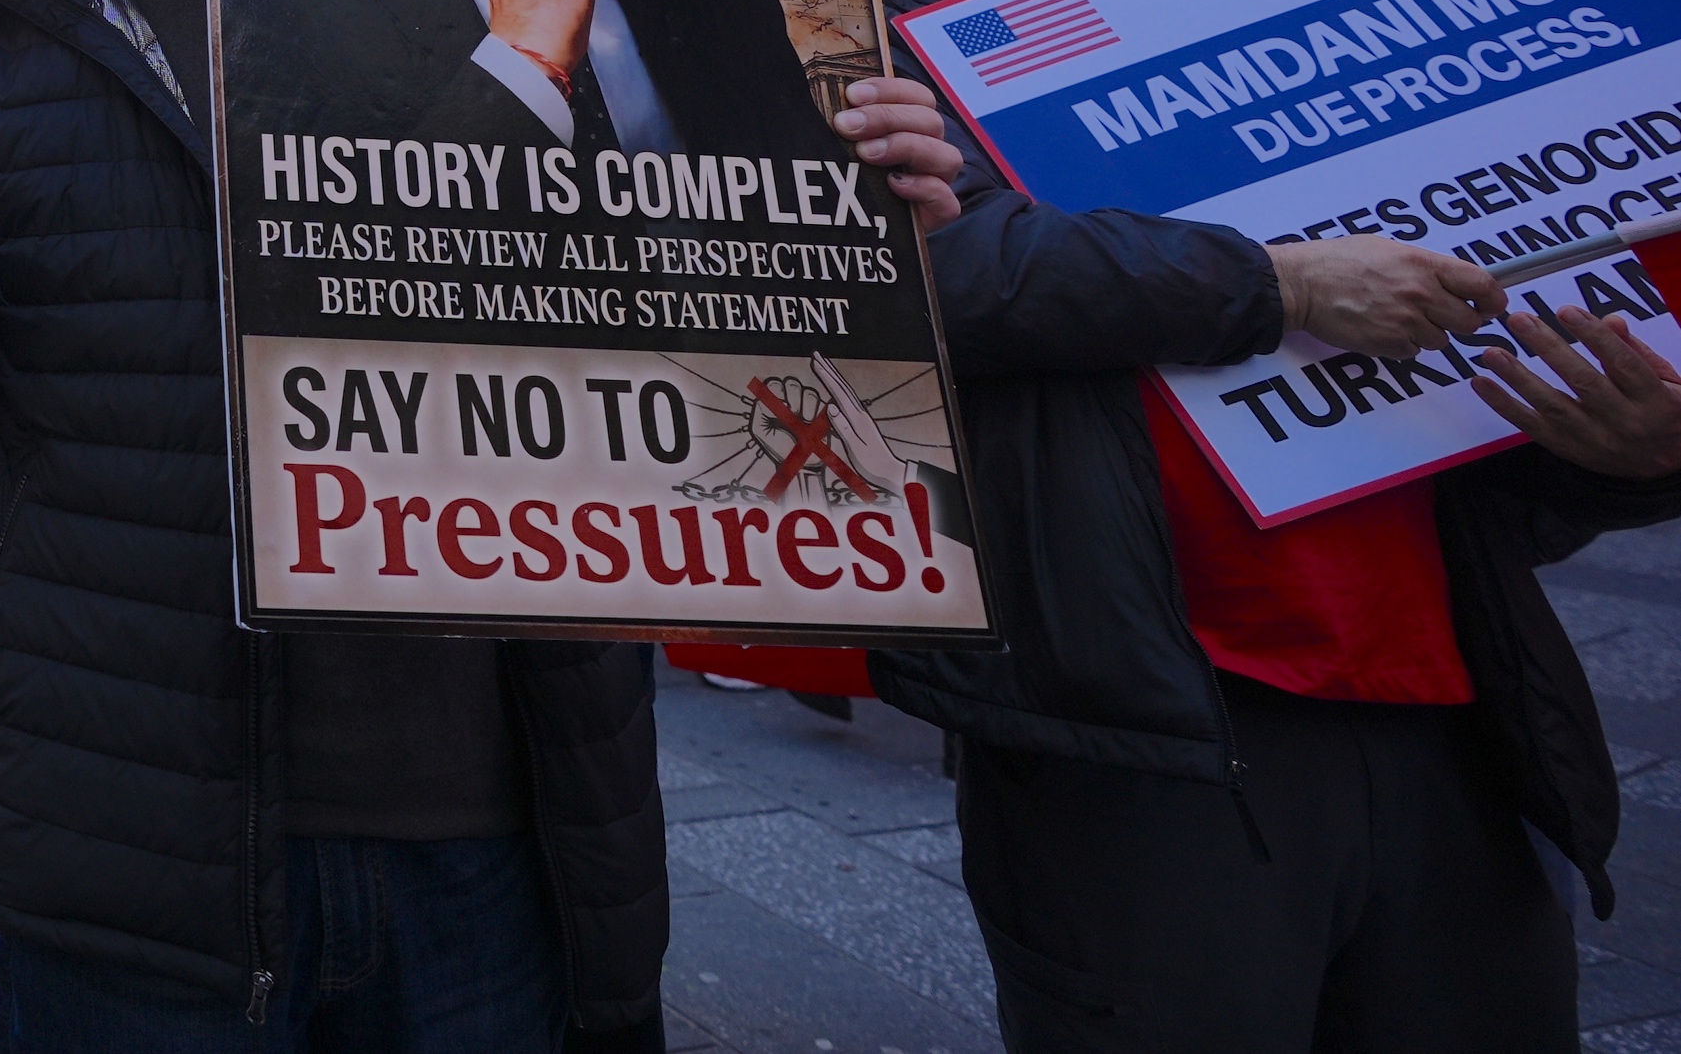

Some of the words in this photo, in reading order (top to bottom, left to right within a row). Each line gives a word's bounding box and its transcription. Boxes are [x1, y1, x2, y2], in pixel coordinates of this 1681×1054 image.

[1231, 89, 1372, 164] DUE
[1351, 6, 1641, 124] PROCESS,
[261, 133, 505, 211] HISTORY
[525, 146, 580, 216] IS
[594, 149, 888, 239] COMPLEX,
[1420, 102, 1681, 227] GENOCID
[258, 219, 396, 264] PLEASE
[403, 226, 549, 270] REVIEW
[559, 234, 629, 273] ALL
[638, 238, 898, 284] PERSPECTIVES
[1451, 172, 1681, 267] INNOCE
[318, 276, 464, 319] BEFORE
[474, 283, 628, 327] MAKING
[637, 292, 850, 336] STATEMENT
[282, 366, 429, 454] SAY
[455, 373, 567, 460] NO
[586, 378, 691, 464] TO
[282, 462, 947, 595] Pressures!
